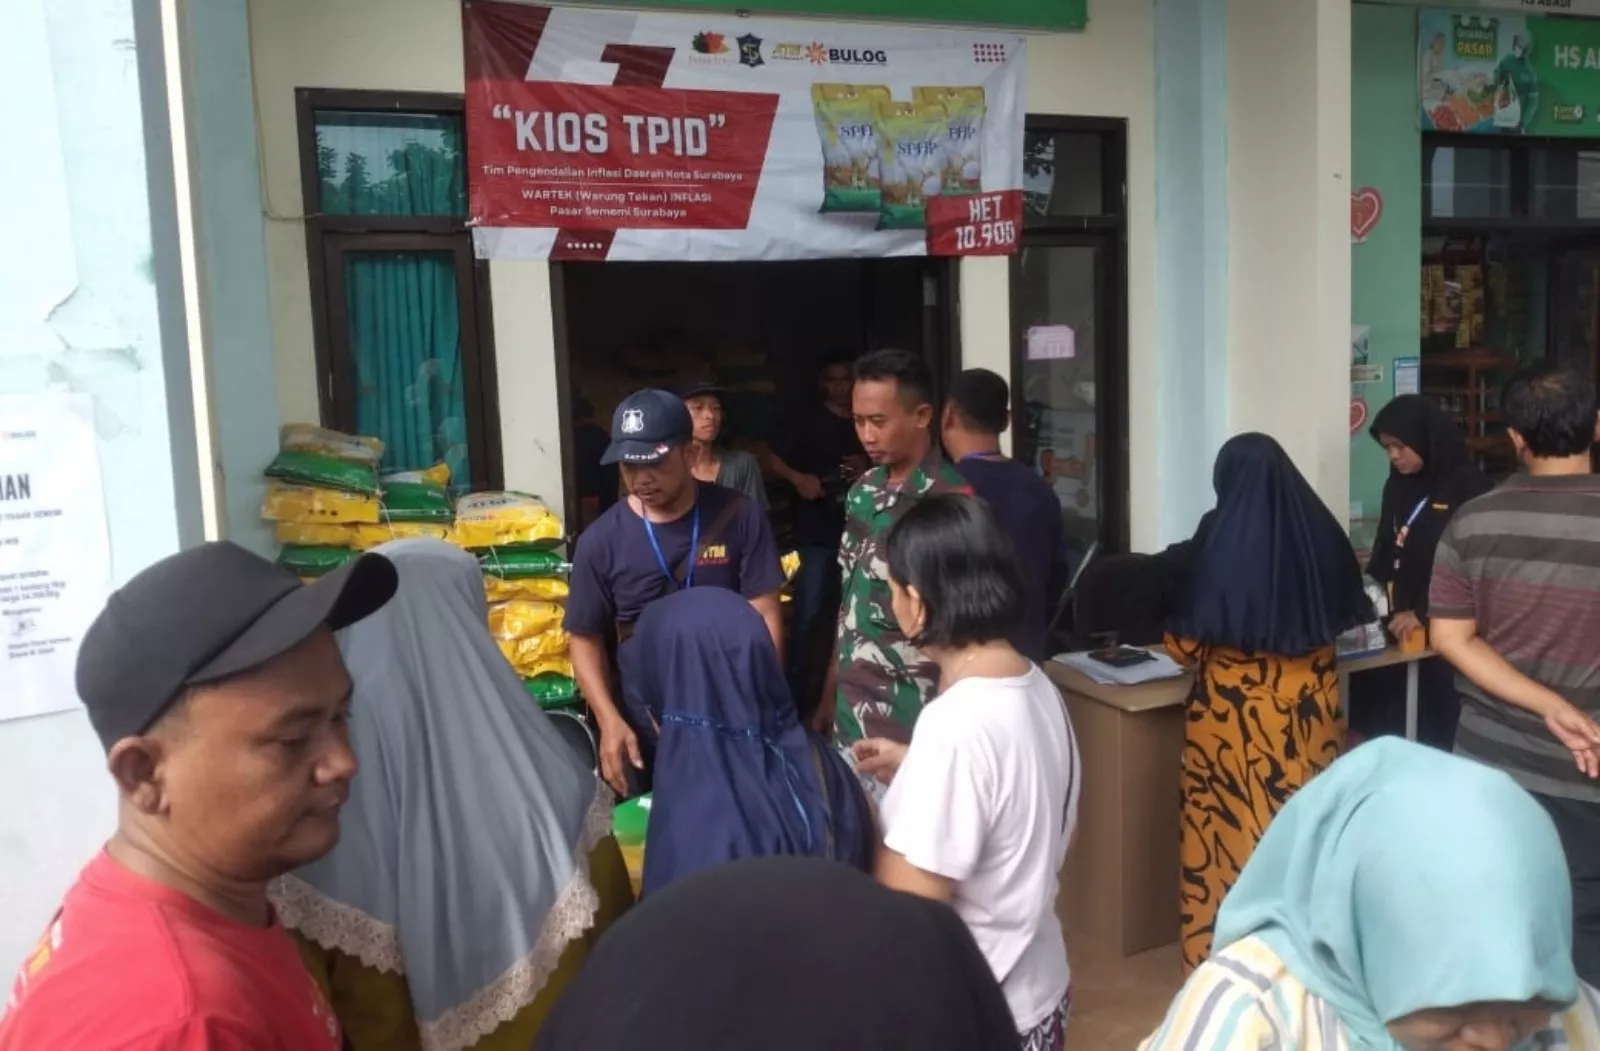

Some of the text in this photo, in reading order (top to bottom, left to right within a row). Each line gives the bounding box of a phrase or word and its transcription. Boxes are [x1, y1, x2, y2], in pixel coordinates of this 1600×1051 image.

[829, 48, 887, 63] BULOG
[1554, 44, 1580, 69] HS
[483, 165, 743, 182] Tim Pengendalian Inflasi Daerah Kota Surabaya
[522, 189, 572, 200] WARTEK
[670, 193, 712, 202] INFLASI
[550, 205, 582, 216] Pasar
[969, 196, 1002, 222] HET
[956, 220, 1015, 249] 10.900
